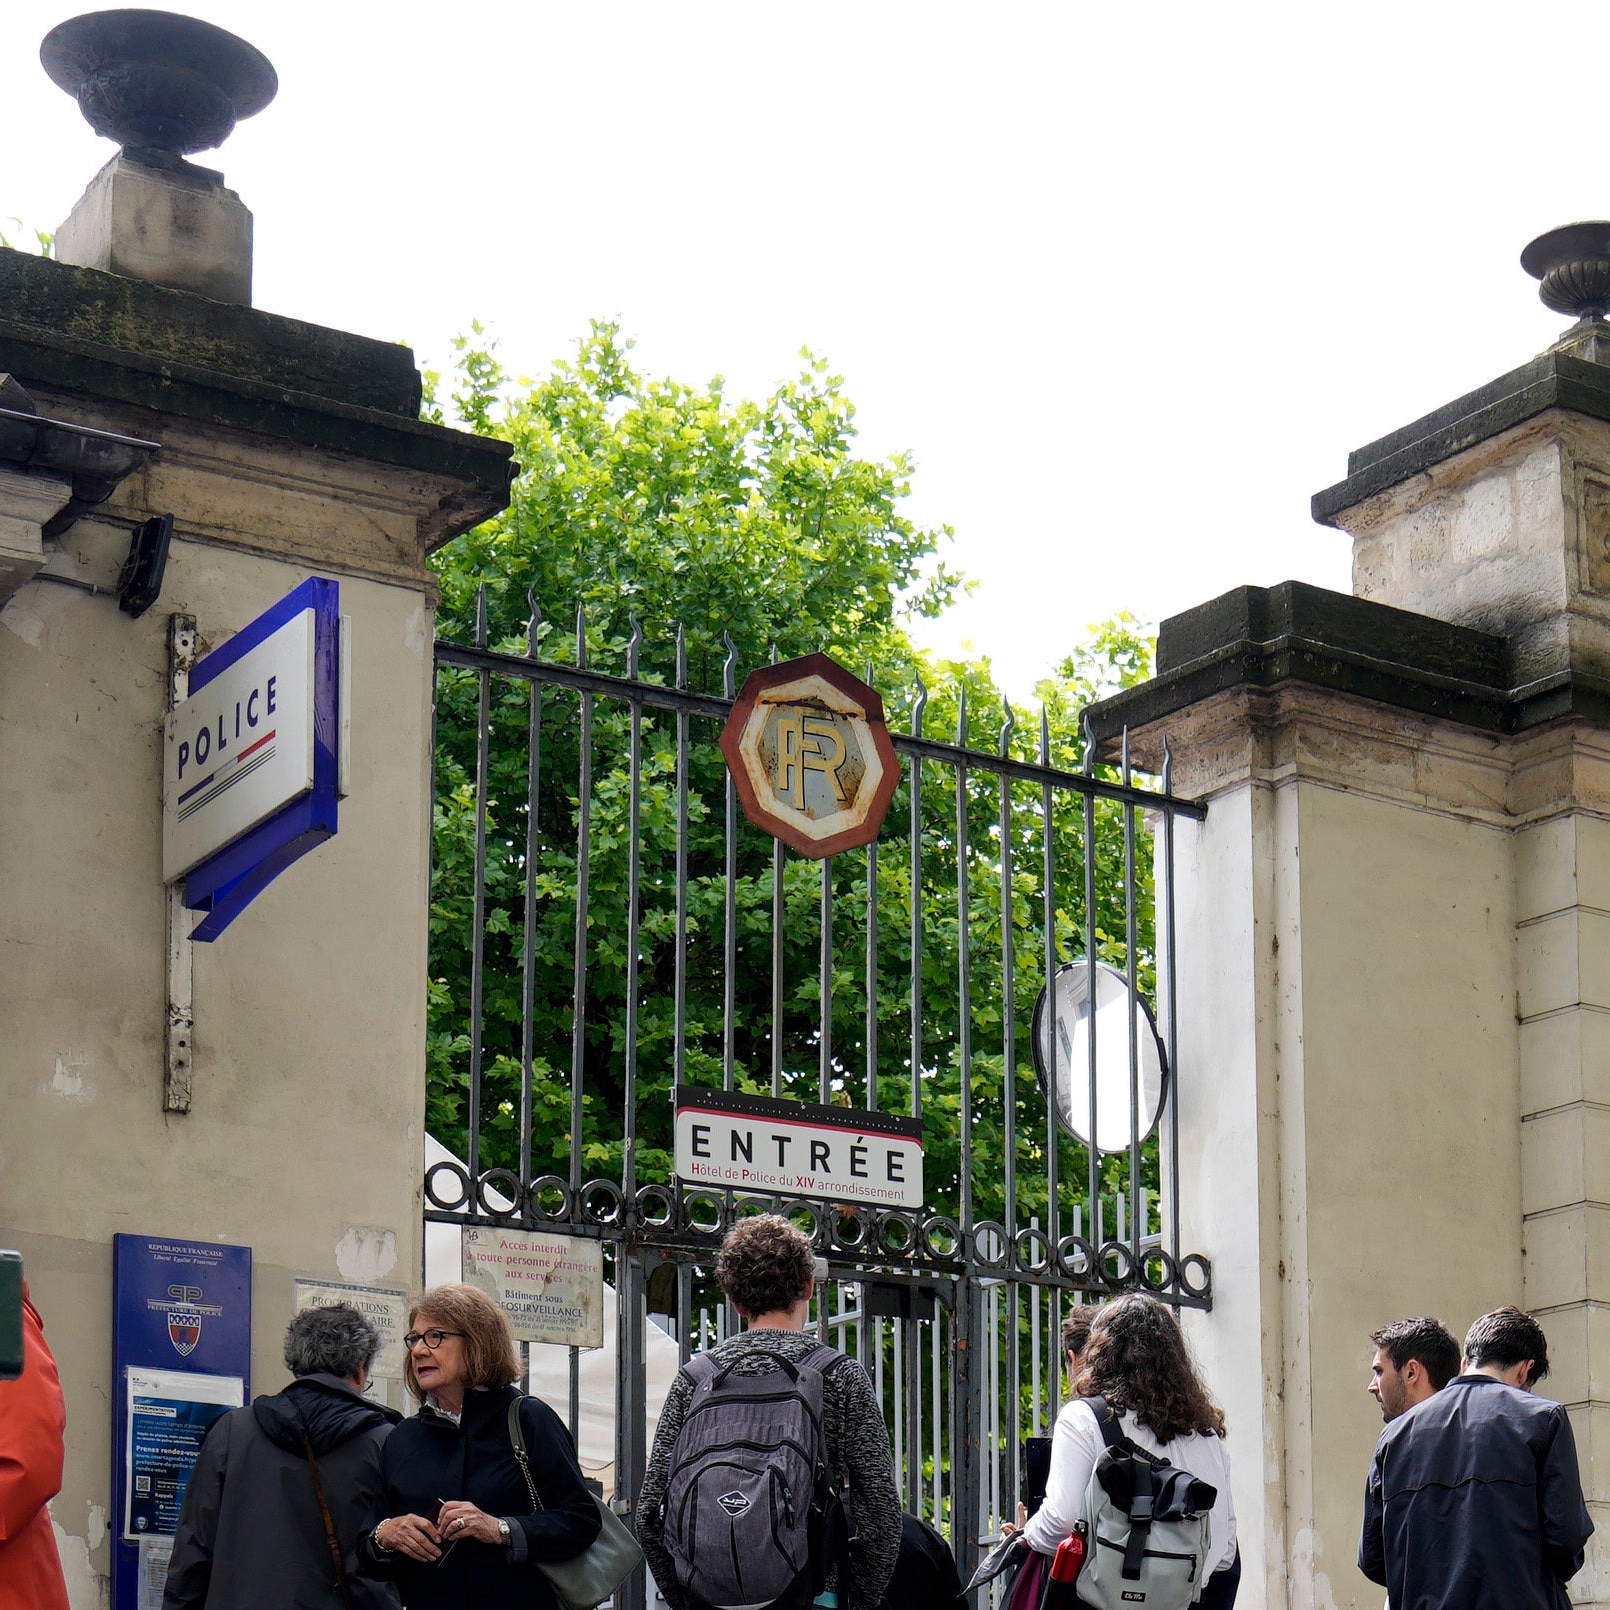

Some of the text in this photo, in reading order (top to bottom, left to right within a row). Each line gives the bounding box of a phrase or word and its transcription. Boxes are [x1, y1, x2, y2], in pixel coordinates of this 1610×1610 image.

[178, 675, 277, 780] POLICE
[692, 1124, 905, 1183] ENTRÉE
[691, 1162, 905, 1200] Hôtel de Police du XIV arrondissement
[499, 1239, 568, 1255] Accès interdit
[476, 1252, 503, 1262] toute
[506, 1255, 551, 1268] personne
[505, 1269, 563, 1283] aux servces
[505, 1289, 563, 1303] Bâtiment sous
[496, 1301, 583, 1318] EOSURVEILLANCE
[136, 1445, 160, 1453] Prenez
